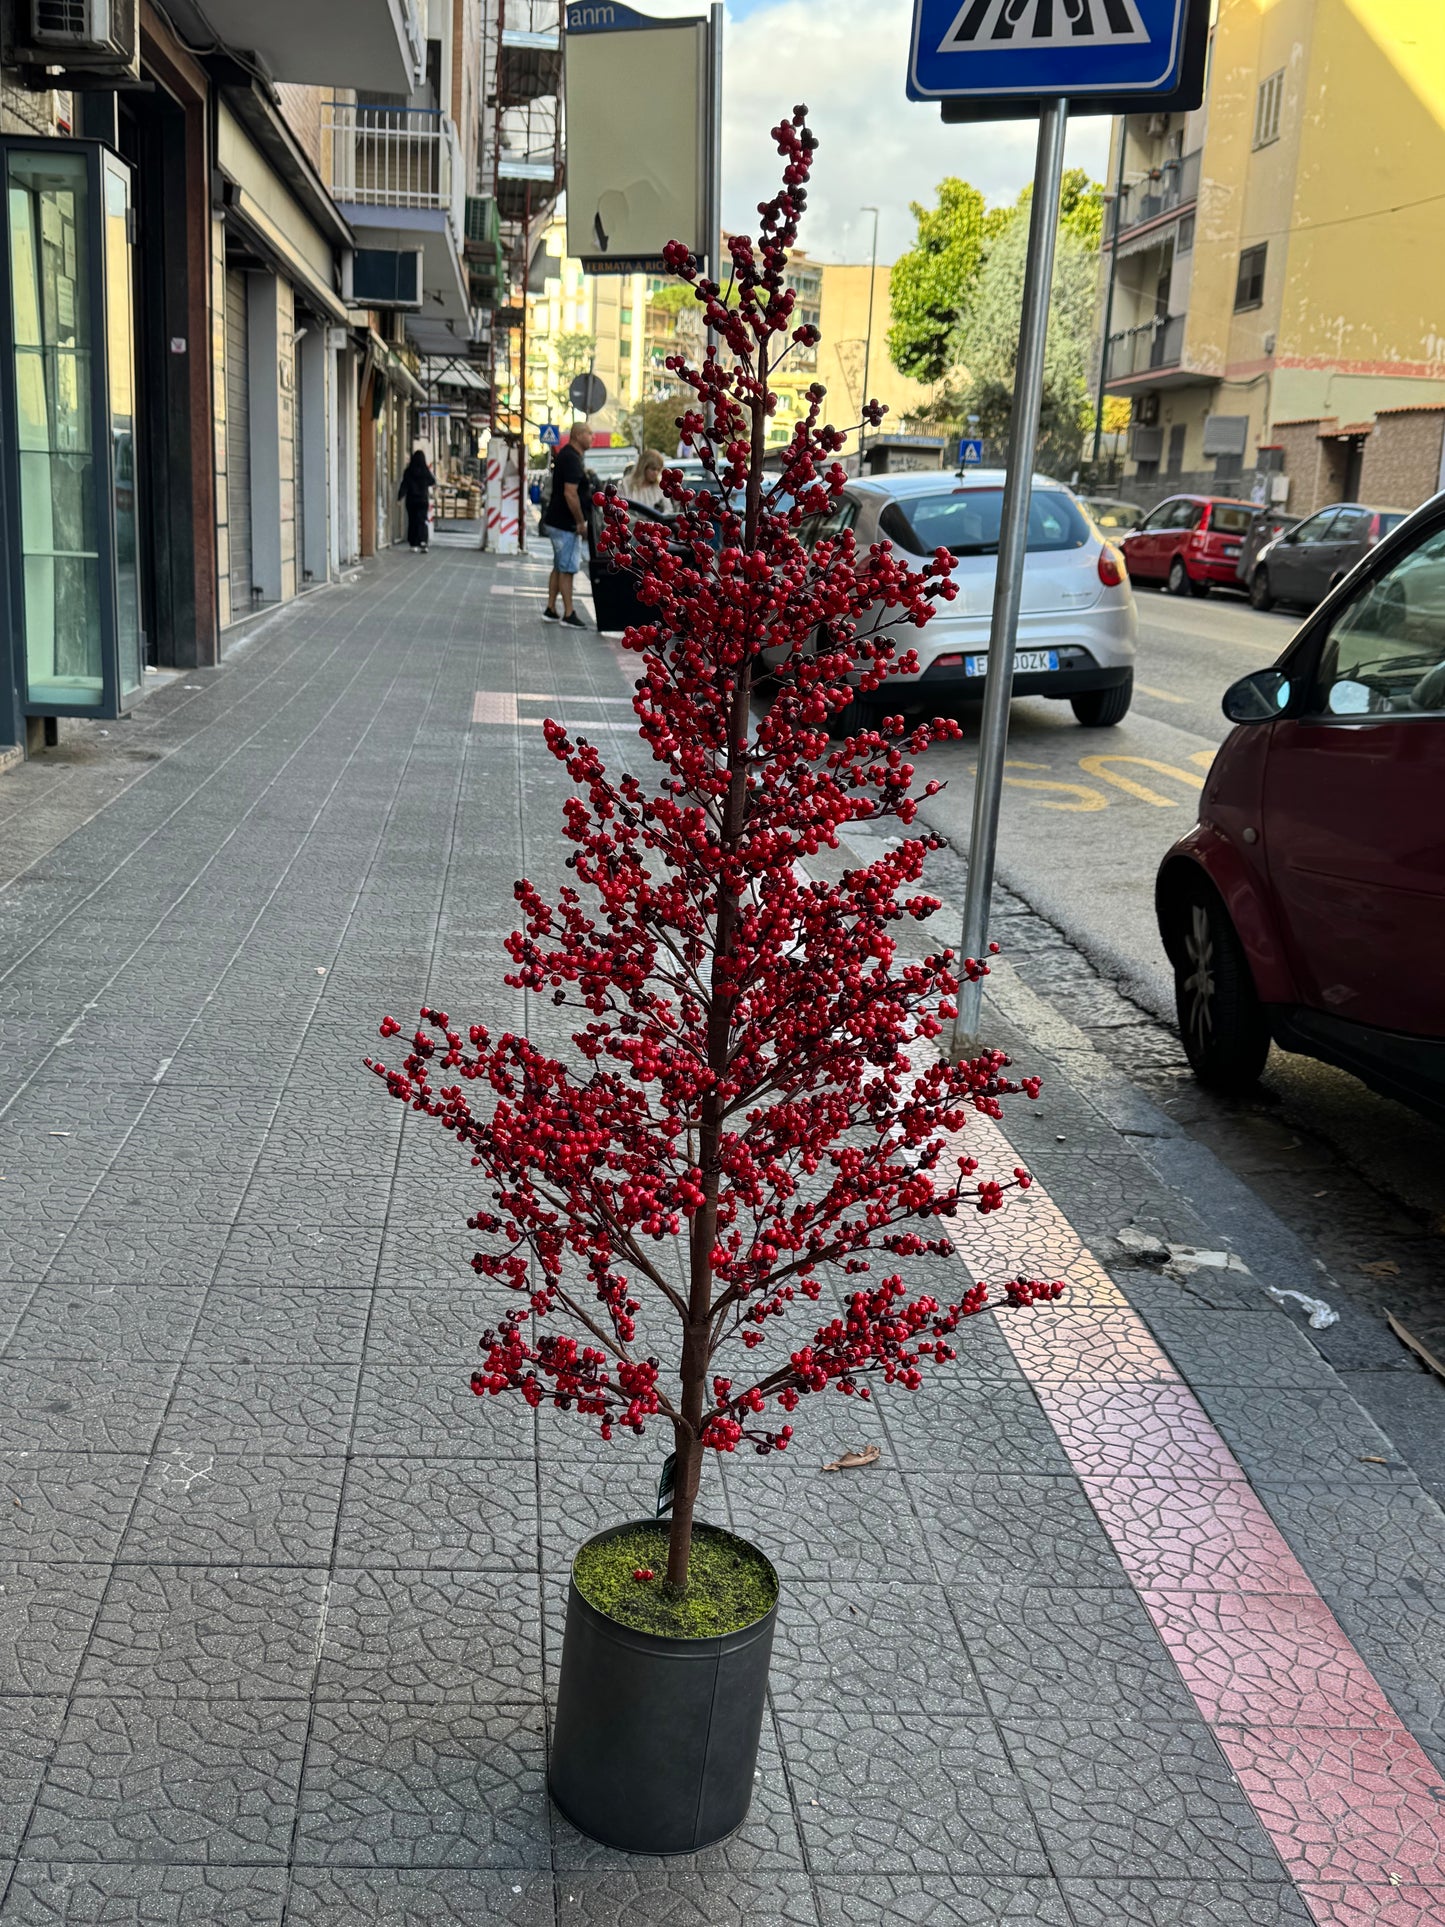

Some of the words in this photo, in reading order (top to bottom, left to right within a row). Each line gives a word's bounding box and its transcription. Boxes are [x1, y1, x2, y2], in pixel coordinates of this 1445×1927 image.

[570, 6, 615, 27] anm
[585, 261, 633, 273] FERMATA
[634, 261, 644, 272] A
